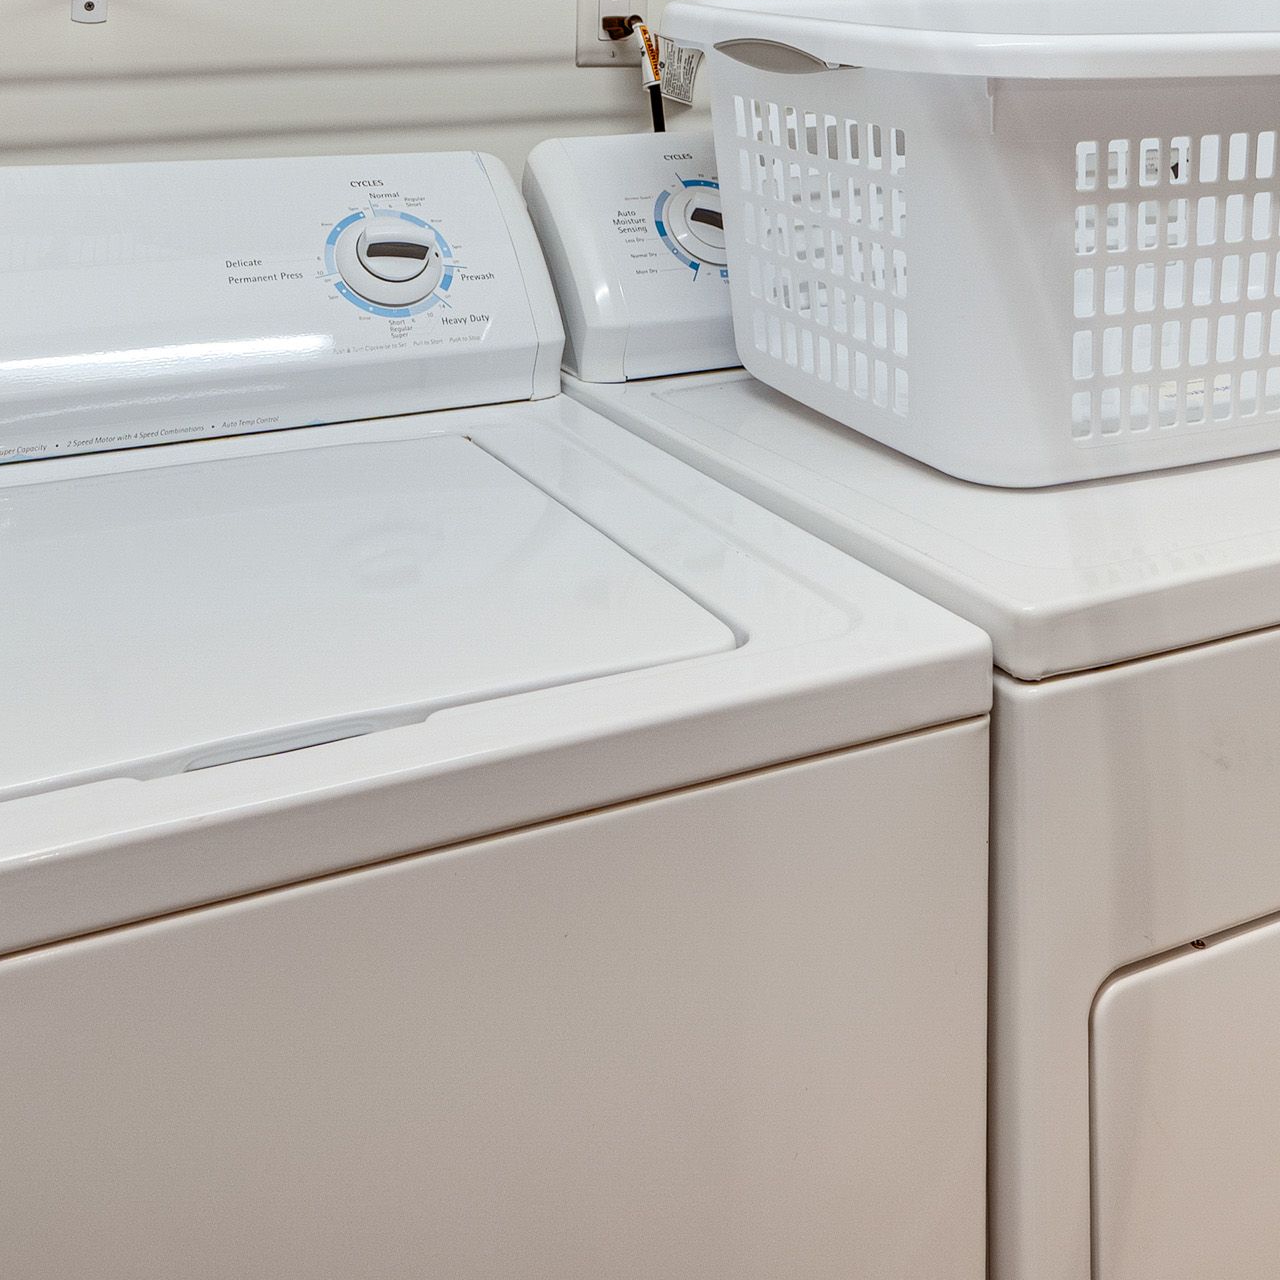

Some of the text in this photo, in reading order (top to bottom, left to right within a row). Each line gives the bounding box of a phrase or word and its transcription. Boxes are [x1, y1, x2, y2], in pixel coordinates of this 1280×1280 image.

[663, 153, 693, 161] CYCLES
[350, 179, 385, 188] CYCLES
[369, 192, 400, 200] Normal
[612, 217, 647, 226] Moisture
[617, 225, 648, 234] Sensing
[225, 258, 263, 268] Delicate
[228, 271, 304, 285] Permanent Press
[460, 272, 495, 282] Prewash
[441, 313, 490, 327] Heavy Duty
[389, 325, 414, 333] Regular
[390, 331, 409, 339] Super
[221, 420, 238, 429] Auto
[255, 415, 280, 424] Control
[72, 423, 205, 449] Speed Motor with Speed Combinations
[16, 443, 48, 457] Capacity
